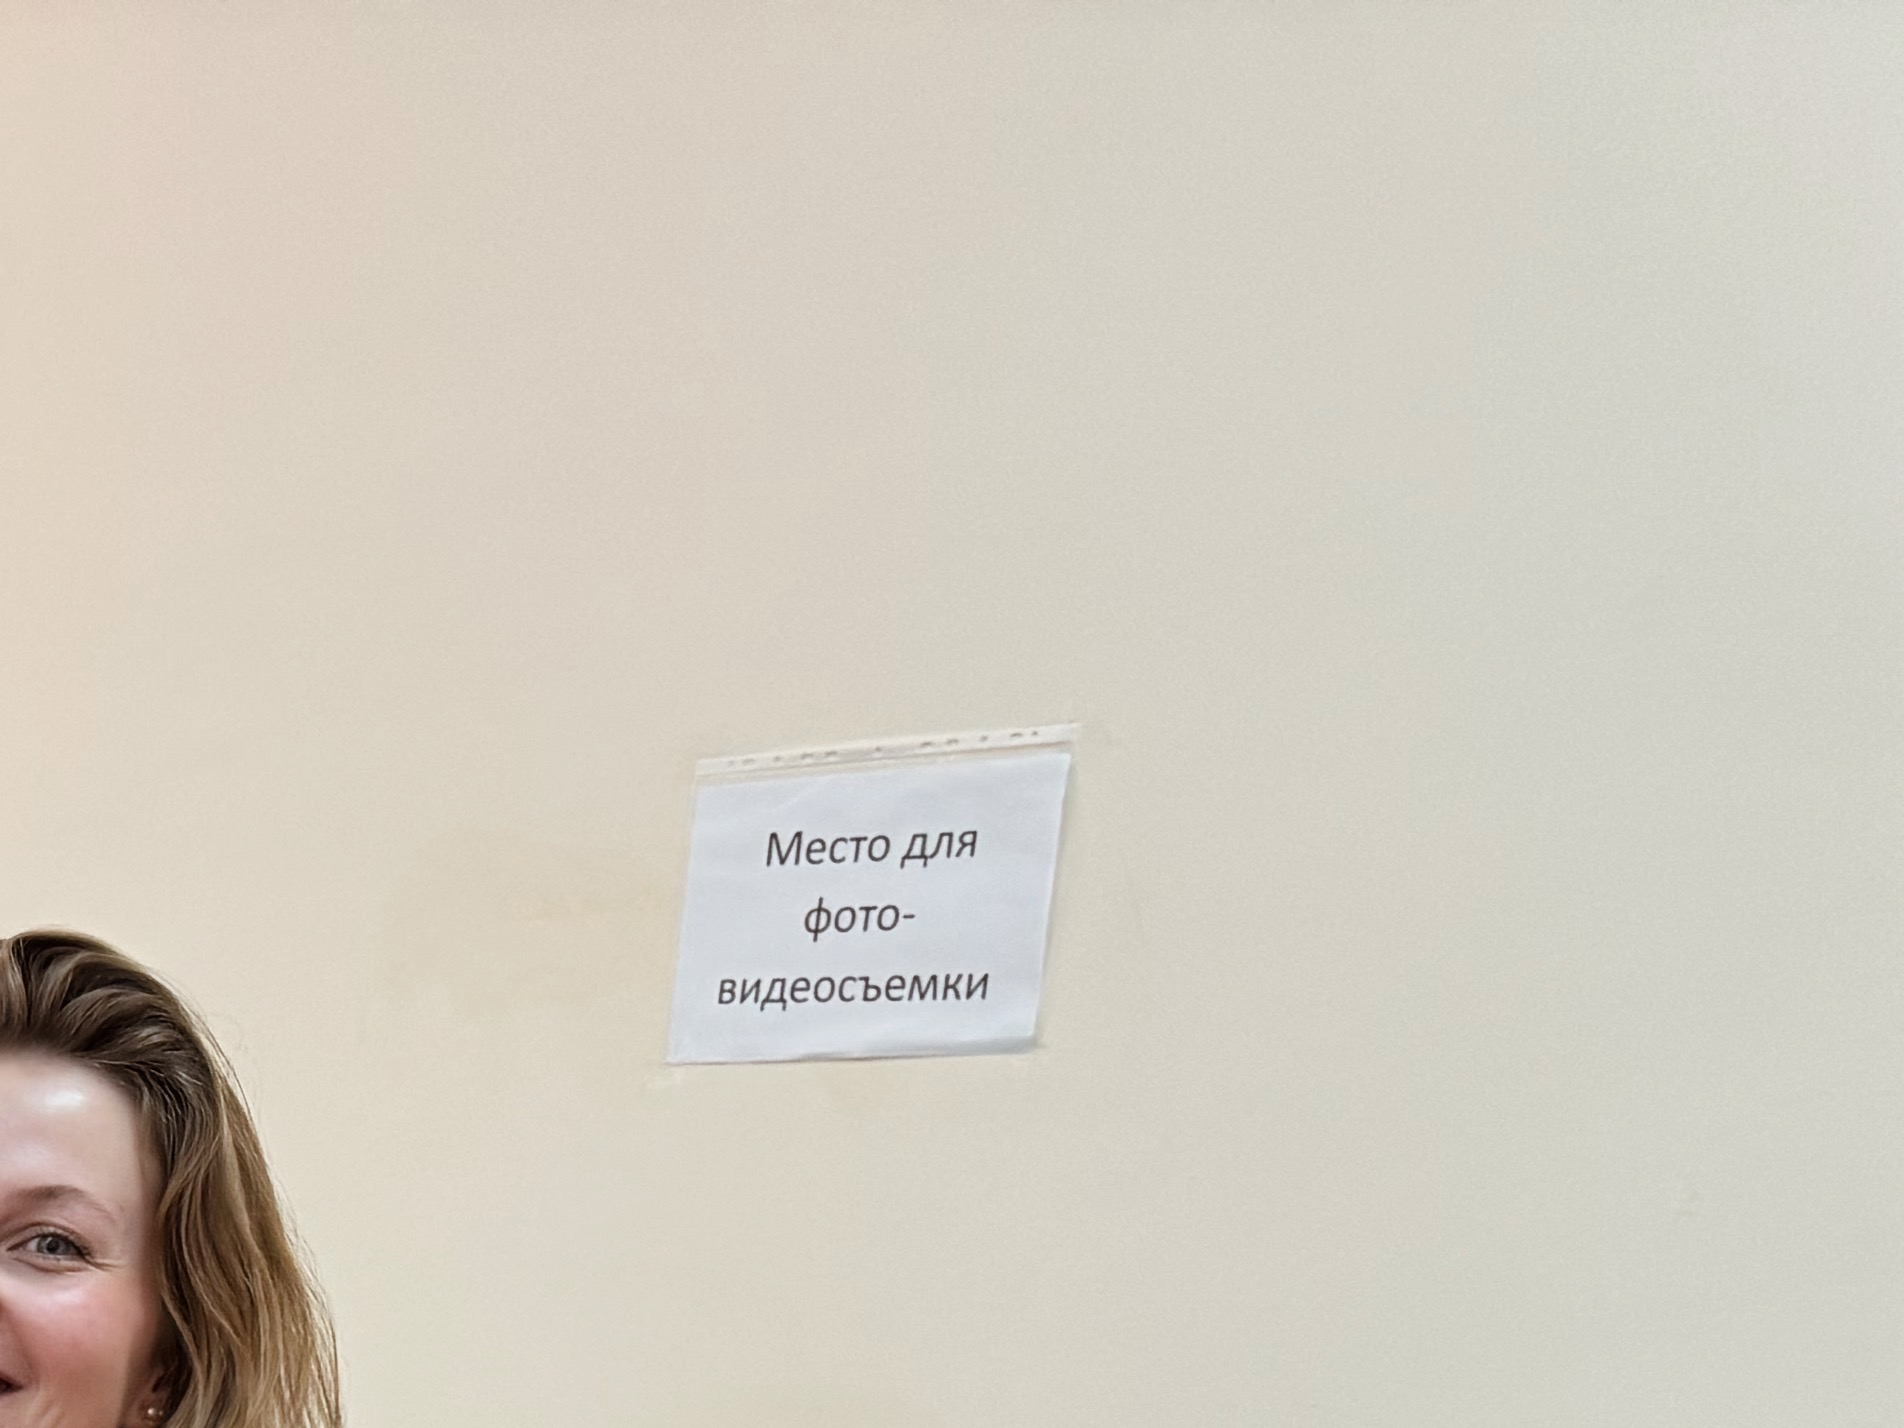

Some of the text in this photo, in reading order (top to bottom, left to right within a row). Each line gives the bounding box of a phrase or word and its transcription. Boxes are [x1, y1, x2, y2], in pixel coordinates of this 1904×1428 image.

[766, 829, 978, 869] Место для
[804, 896, 916, 943] фото-
[717, 972, 990, 1012] видеосъемки
